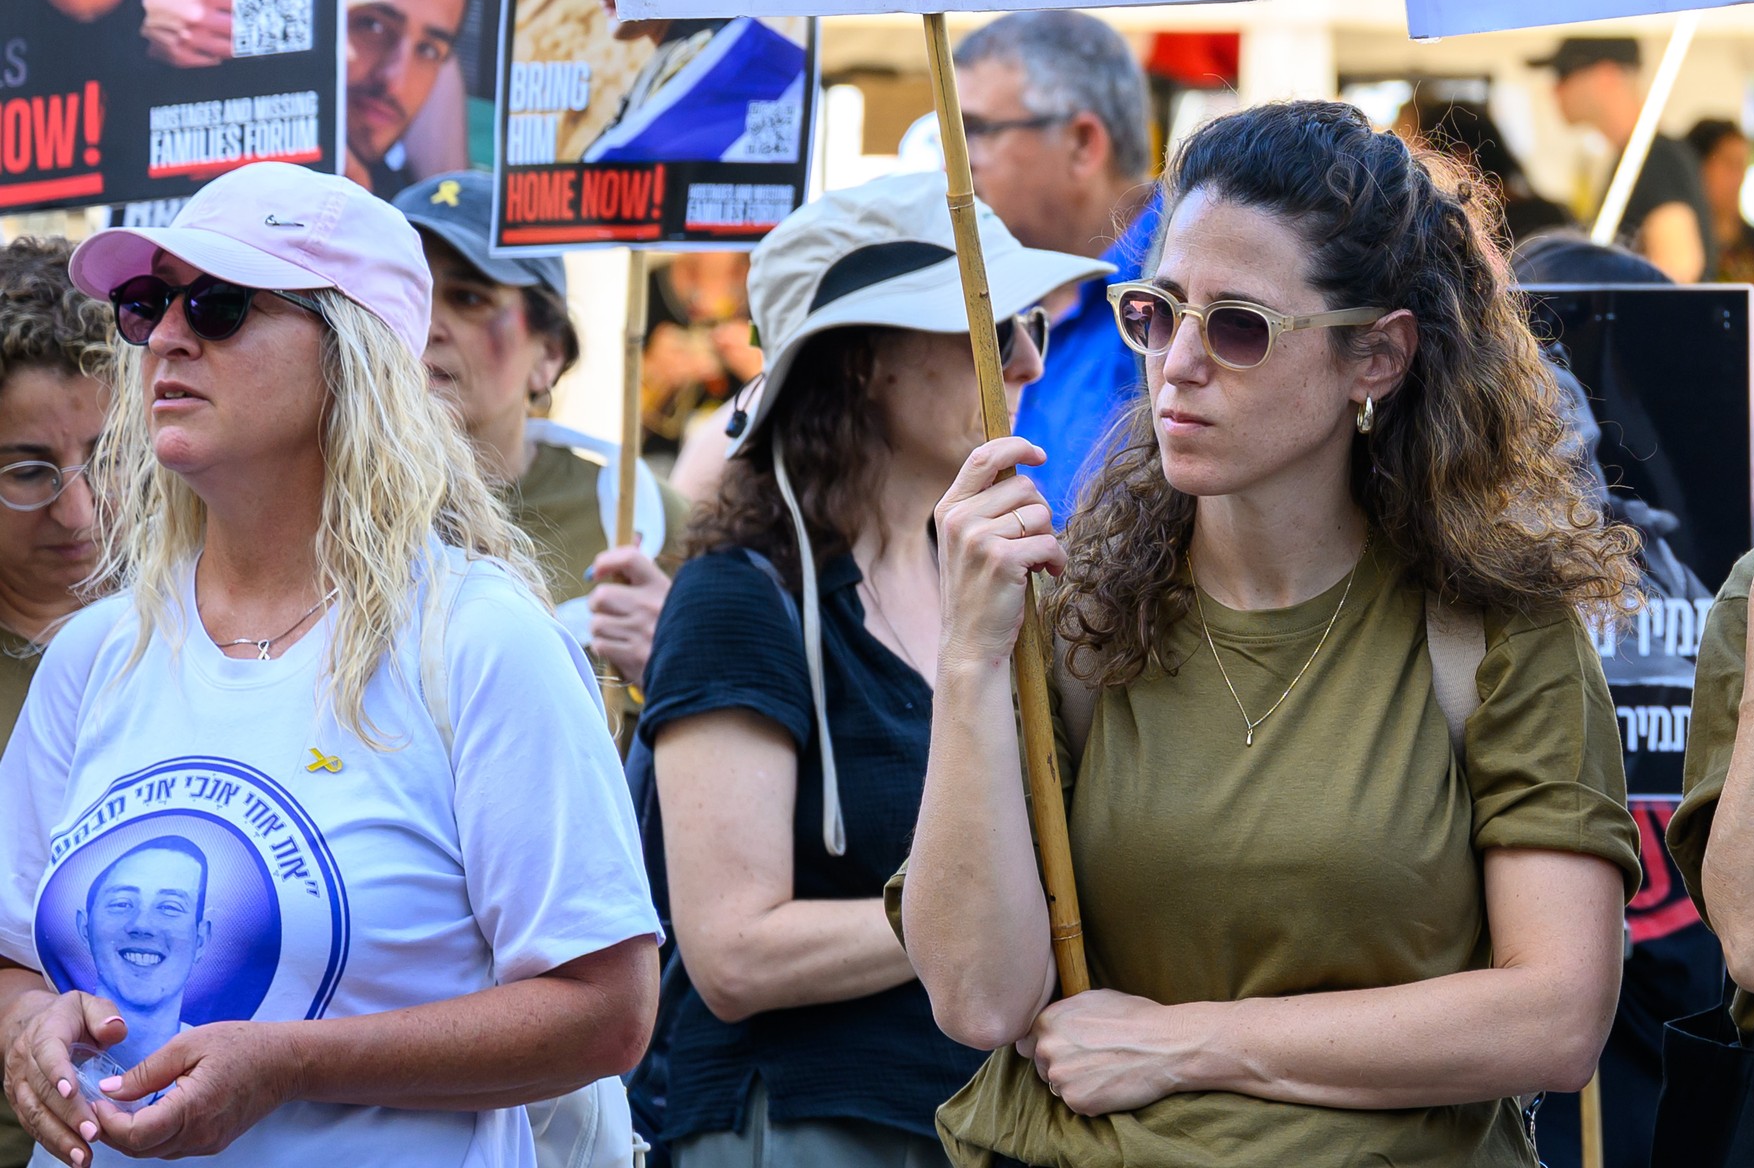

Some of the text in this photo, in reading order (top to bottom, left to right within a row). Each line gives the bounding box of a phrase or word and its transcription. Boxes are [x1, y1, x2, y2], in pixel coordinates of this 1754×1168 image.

[510, 59, 592, 112] BRING
[0, 81, 103, 174] OW!
[150, 117, 319, 169] FAMILIES FORUM
[506, 114, 559, 167] HIM
[505, 170, 577, 223] HOME
[581, 163, 667, 222] NOW!
